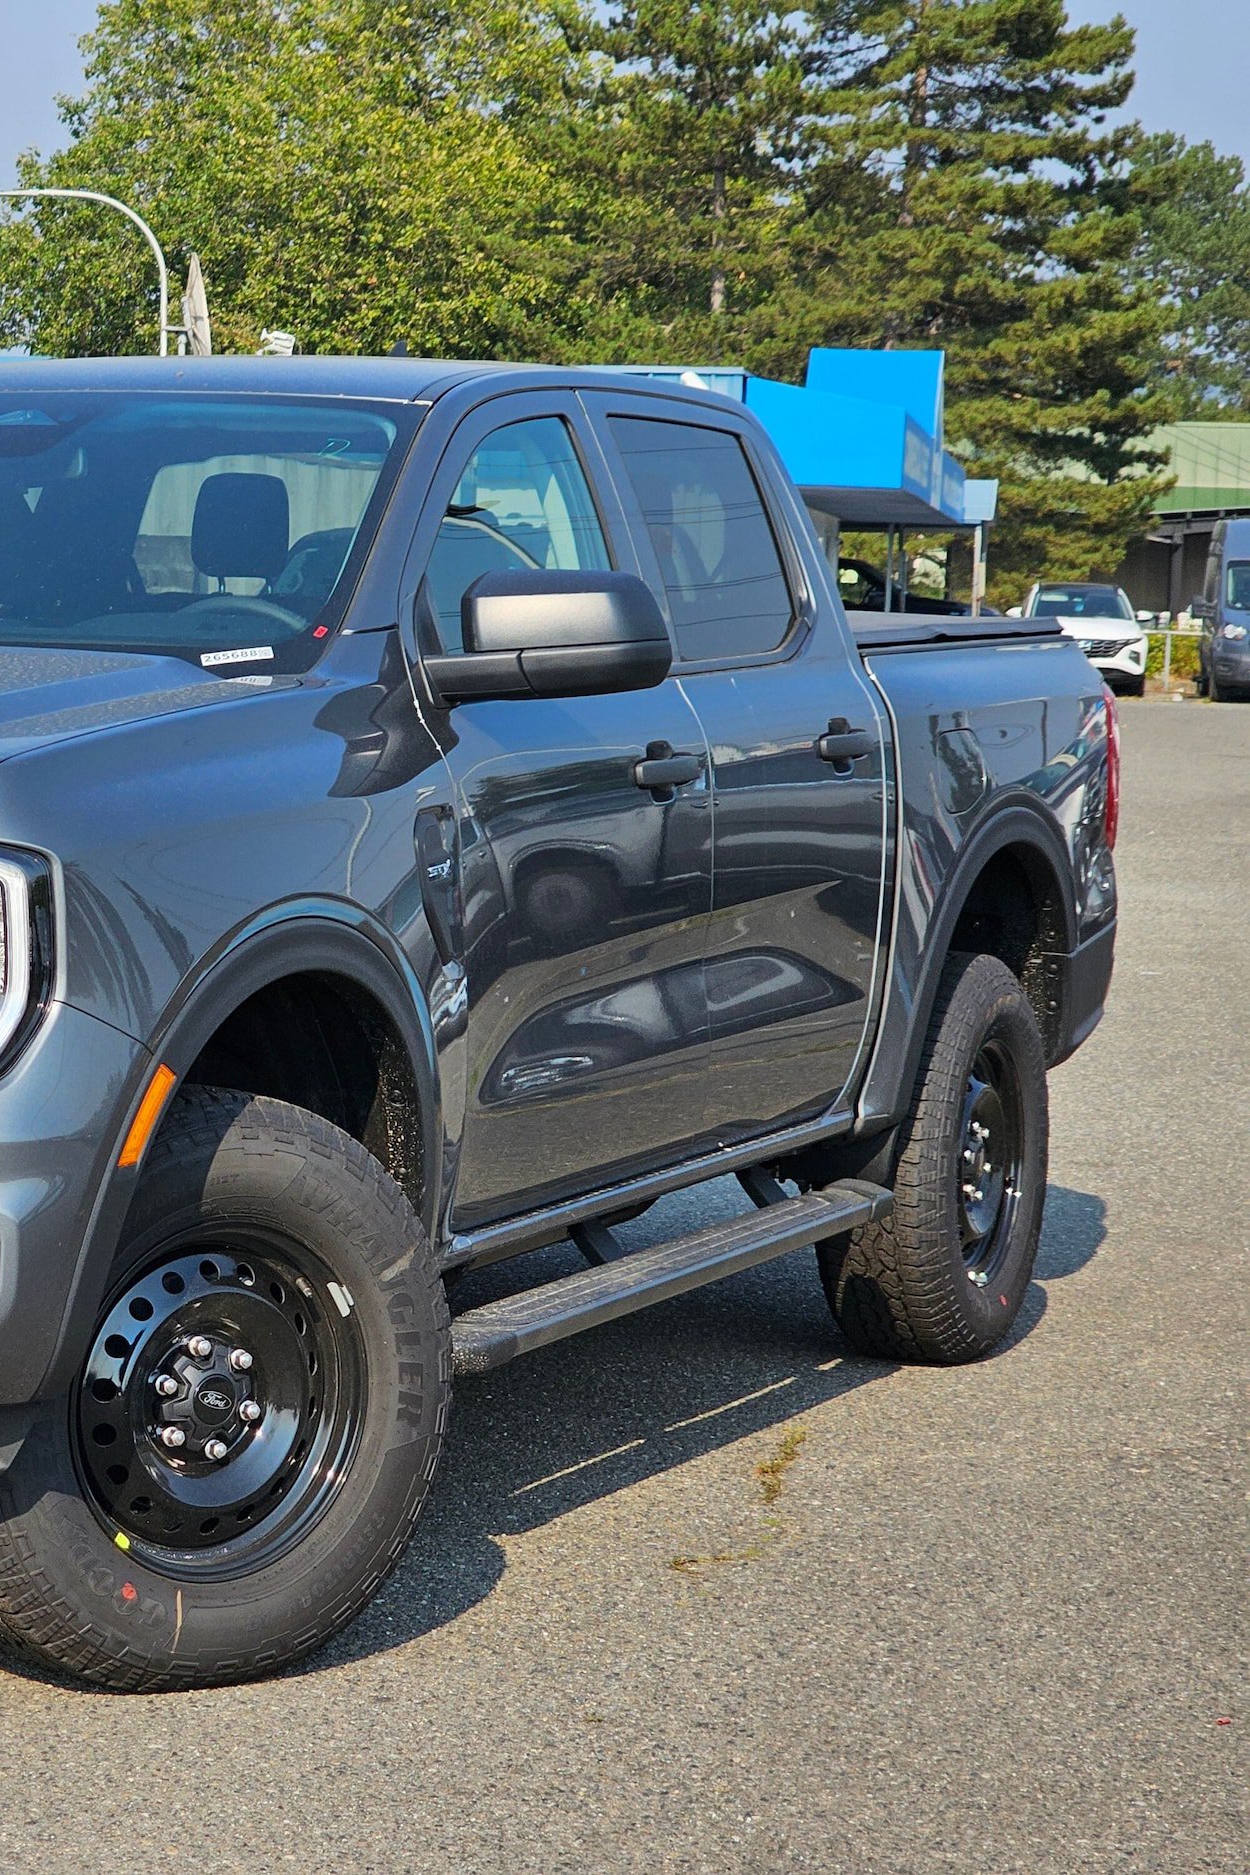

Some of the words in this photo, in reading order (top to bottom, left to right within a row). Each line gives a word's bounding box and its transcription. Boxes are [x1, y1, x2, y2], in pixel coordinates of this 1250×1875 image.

[203, 649, 259, 663] 265688
[297, 1173, 424, 1428] WRANGLER
[203, 1391, 227, 1408] Ford
